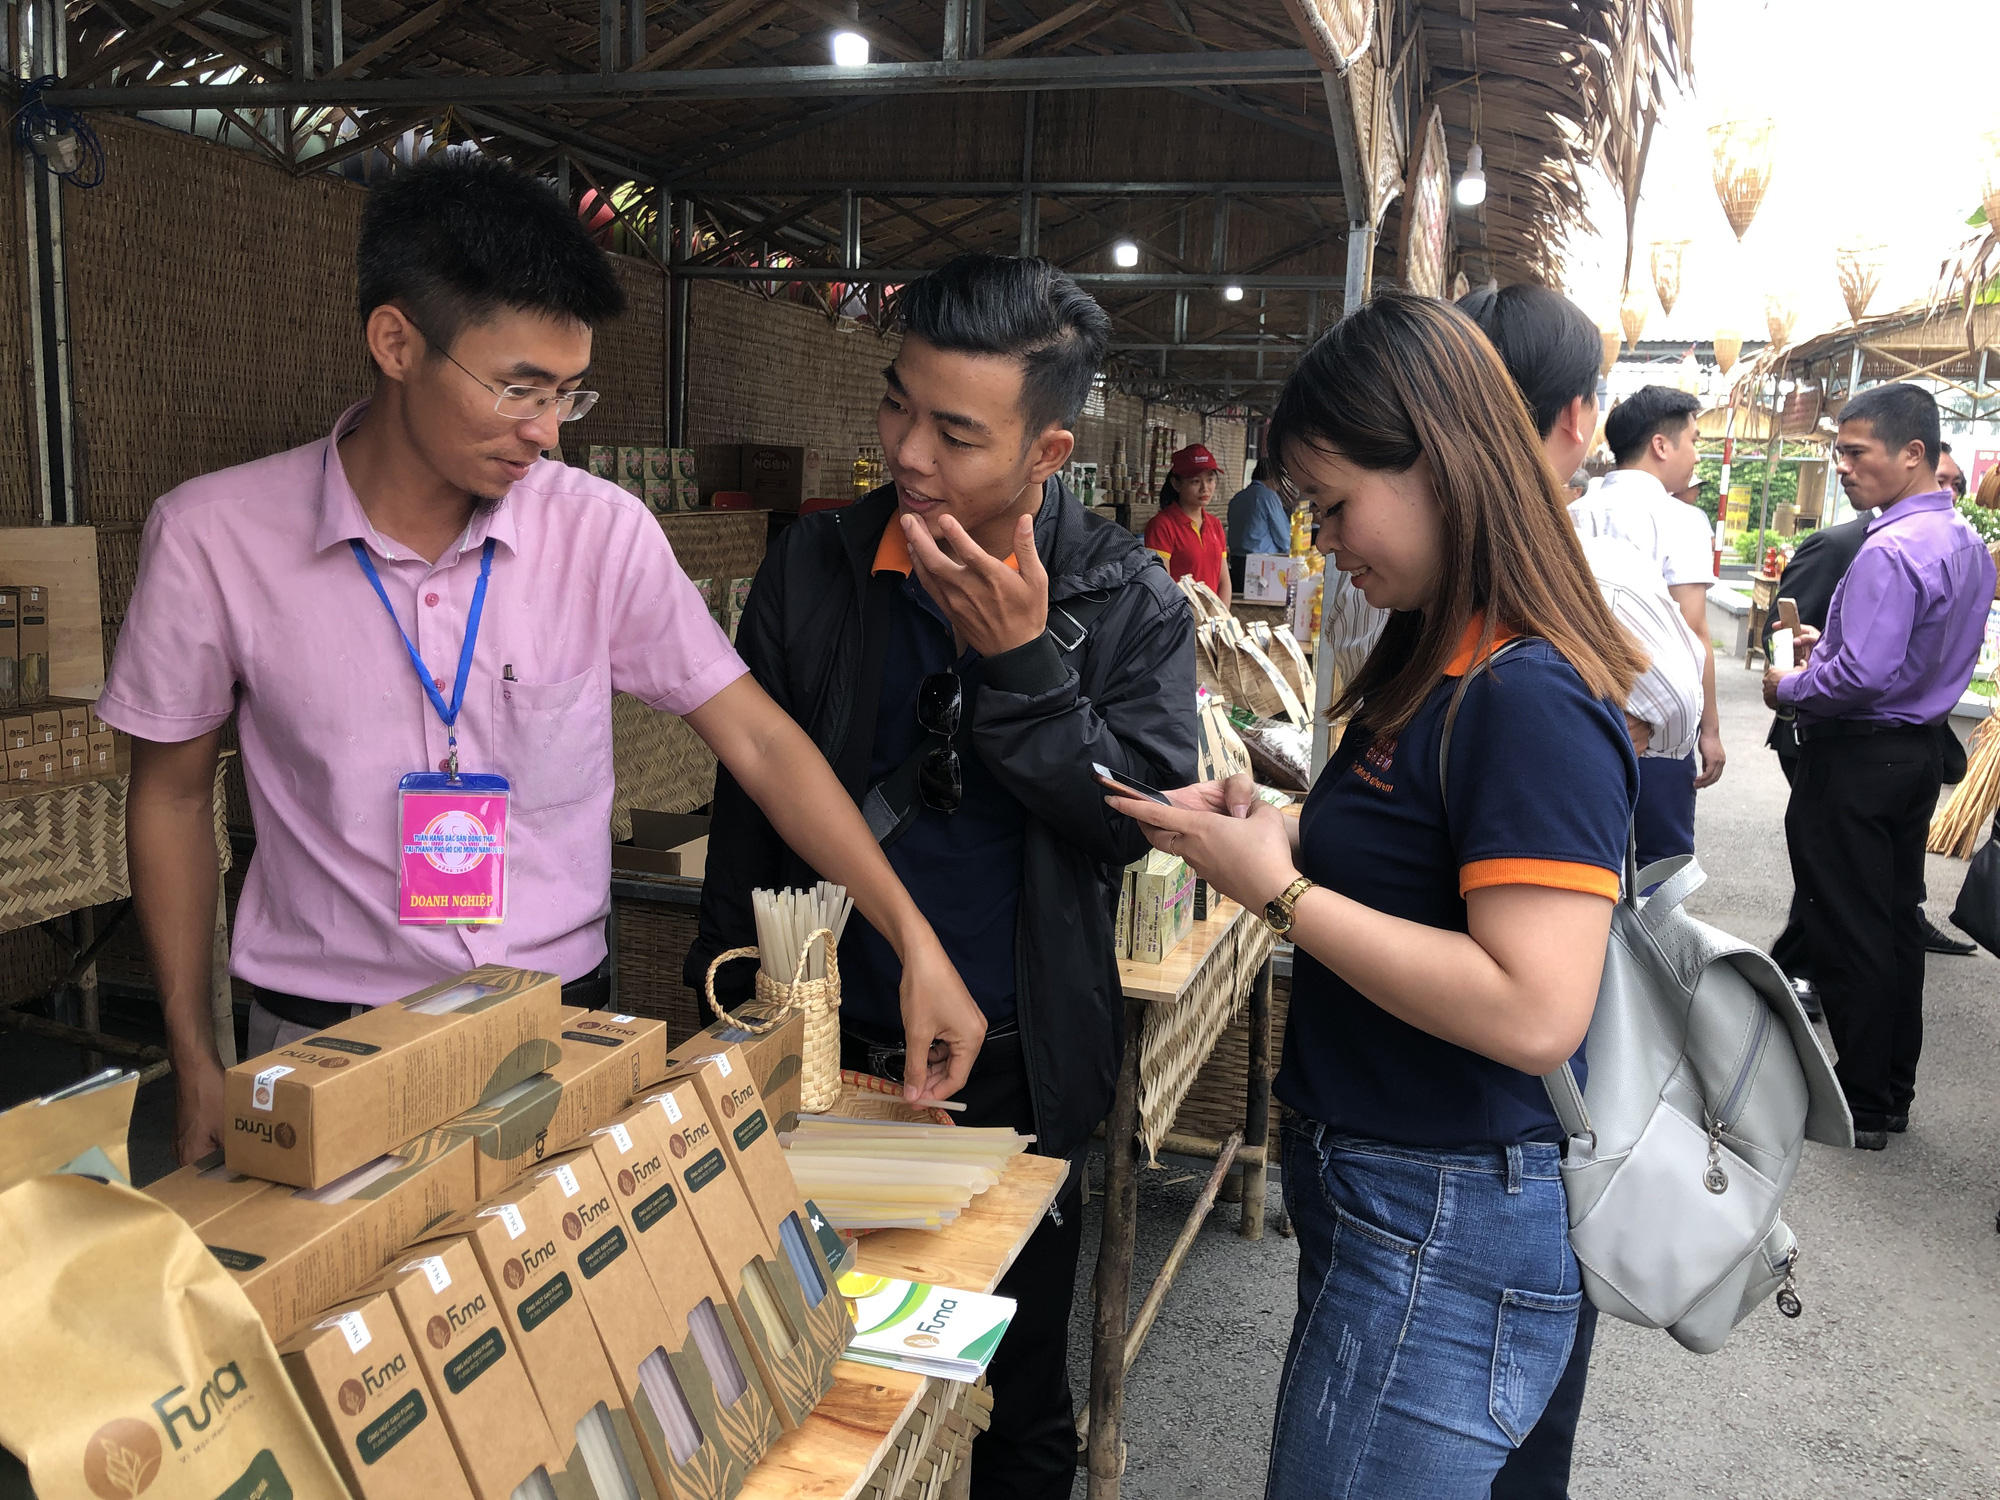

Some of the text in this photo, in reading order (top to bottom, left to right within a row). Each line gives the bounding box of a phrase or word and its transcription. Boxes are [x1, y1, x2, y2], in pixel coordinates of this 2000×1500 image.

[410, 892, 494, 909] DOANH NGHIỆP
[599, 1024, 637, 1036] Fuma
[279, 1050, 325, 1064] Fuma
[731, 1084, 754, 1108] Fuma
[235, 1118, 272, 1144] Fuma
[682, 1122, 710, 1147] Fuma
[632, 1156, 661, 1183] Fuma
[577, 1196, 610, 1227] Fuma
[521, 1240, 557, 1274] Fuma
[446, 1294, 487, 1332] Fuma
[916, 1299, 958, 1335] Fuma
[361, 1353, 407, 1396] Fuma
[151, 1361, 248, 1450] Fuma
